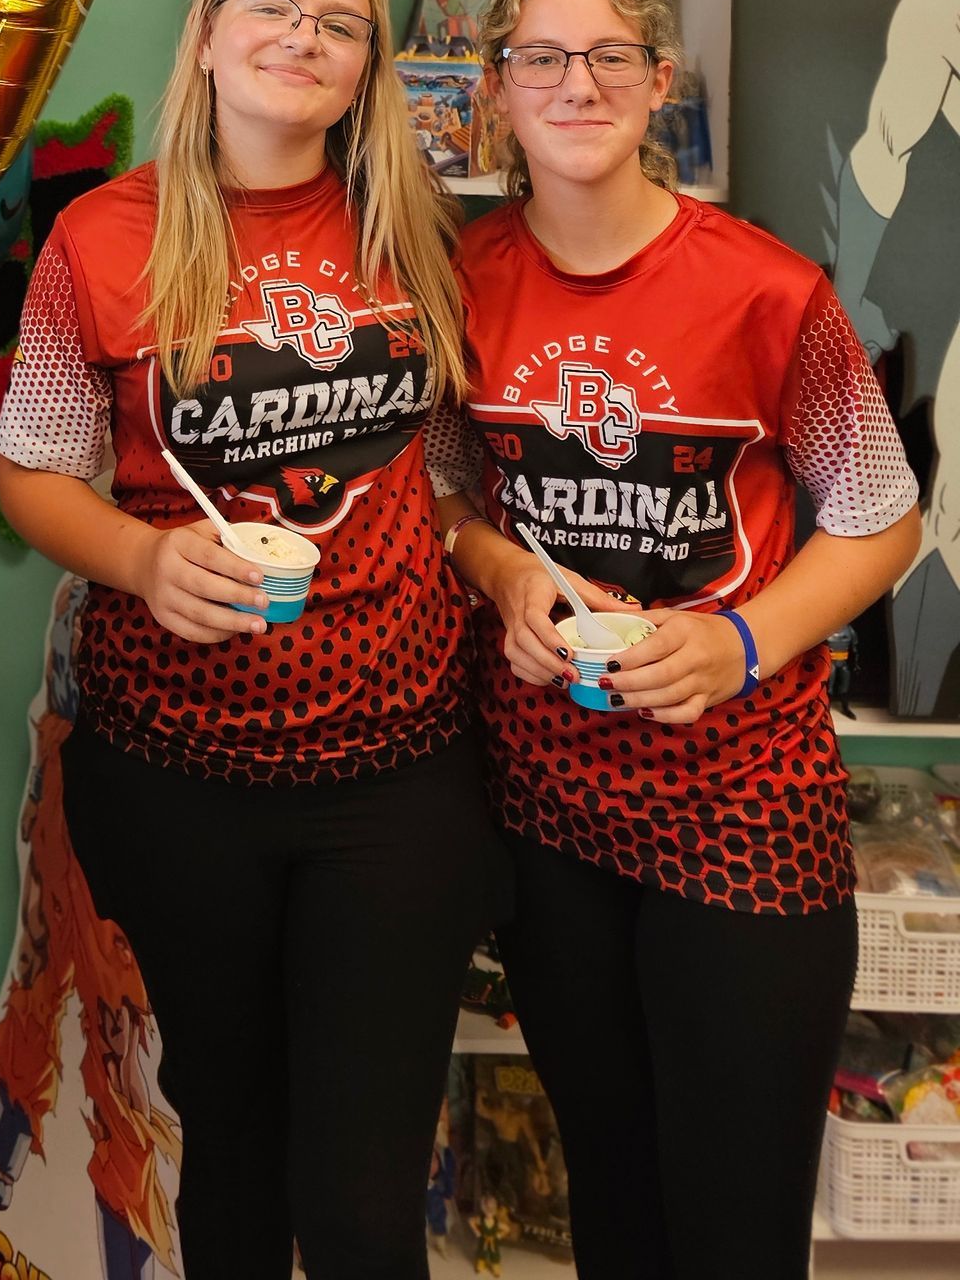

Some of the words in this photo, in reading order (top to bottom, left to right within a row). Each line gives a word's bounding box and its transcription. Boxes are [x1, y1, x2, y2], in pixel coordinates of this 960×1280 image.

[502, 335, 612, 404] BRIDGE
[625, 348, 680, 414] CITY
[170, 367, 435, 445] CARDINAL
[223, 430, 334, 464] MARCHING
[672, 445, 715, 474] 24
[529, 522, 632, 551] MARCHING
[638, 536, 690, 561] BAND
